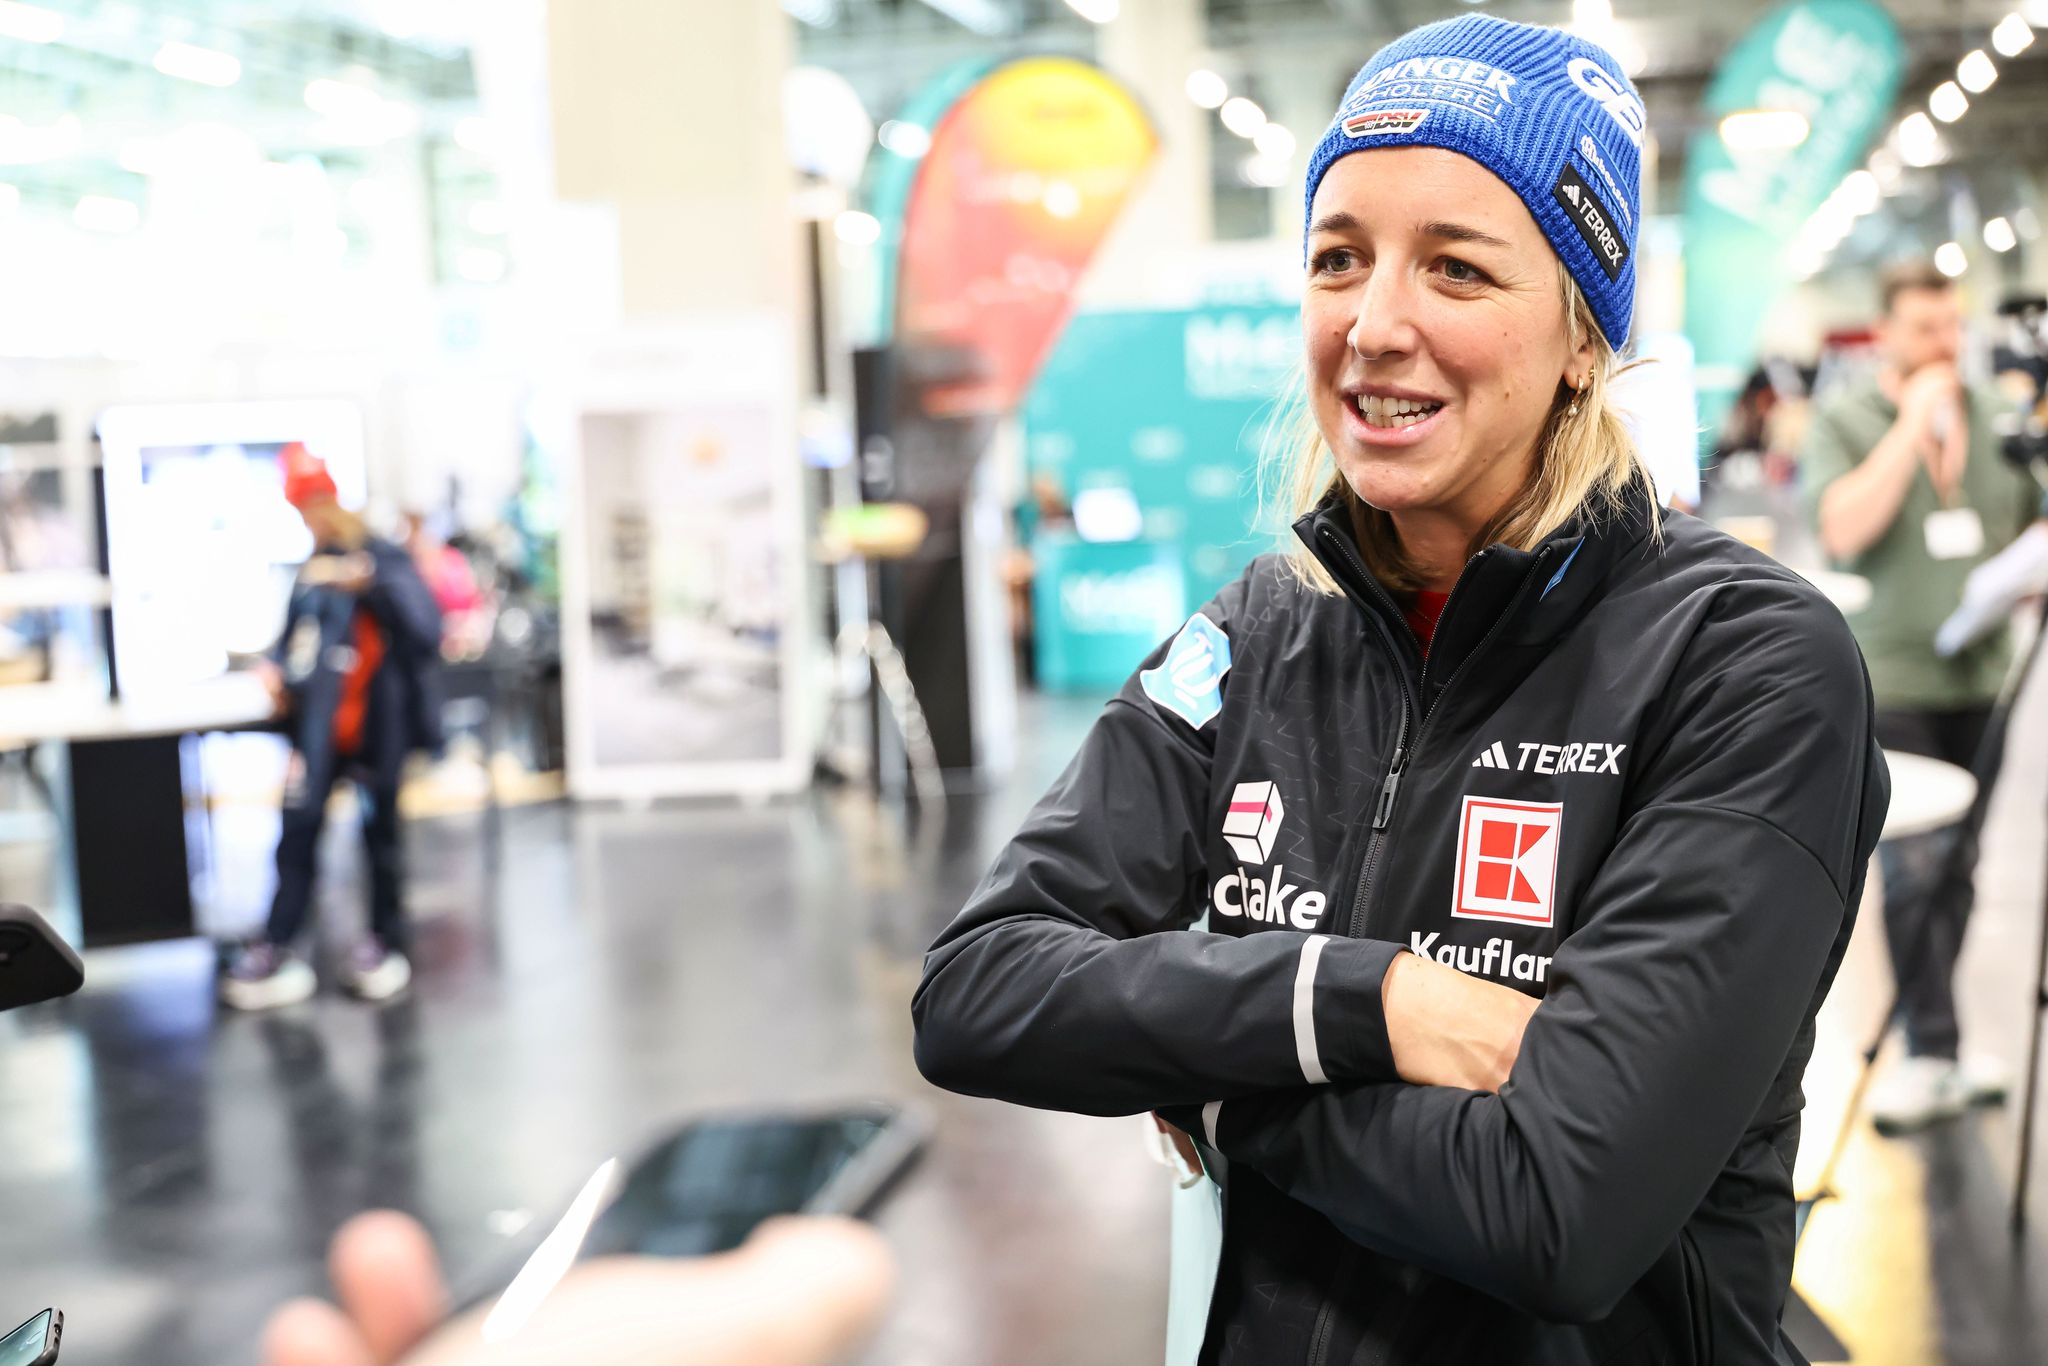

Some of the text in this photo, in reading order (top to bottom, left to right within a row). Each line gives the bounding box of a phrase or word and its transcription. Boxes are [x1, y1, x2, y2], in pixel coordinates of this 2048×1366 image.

[1355, 56, 1516, 106] DINGER
[1580, 197, 1623, 267] TERREX
[1517, 742, 1627, 775] TERREX
[1207, 864, 1326, 930] ctake
[1410, 931, 1553, 982] Kauflan
